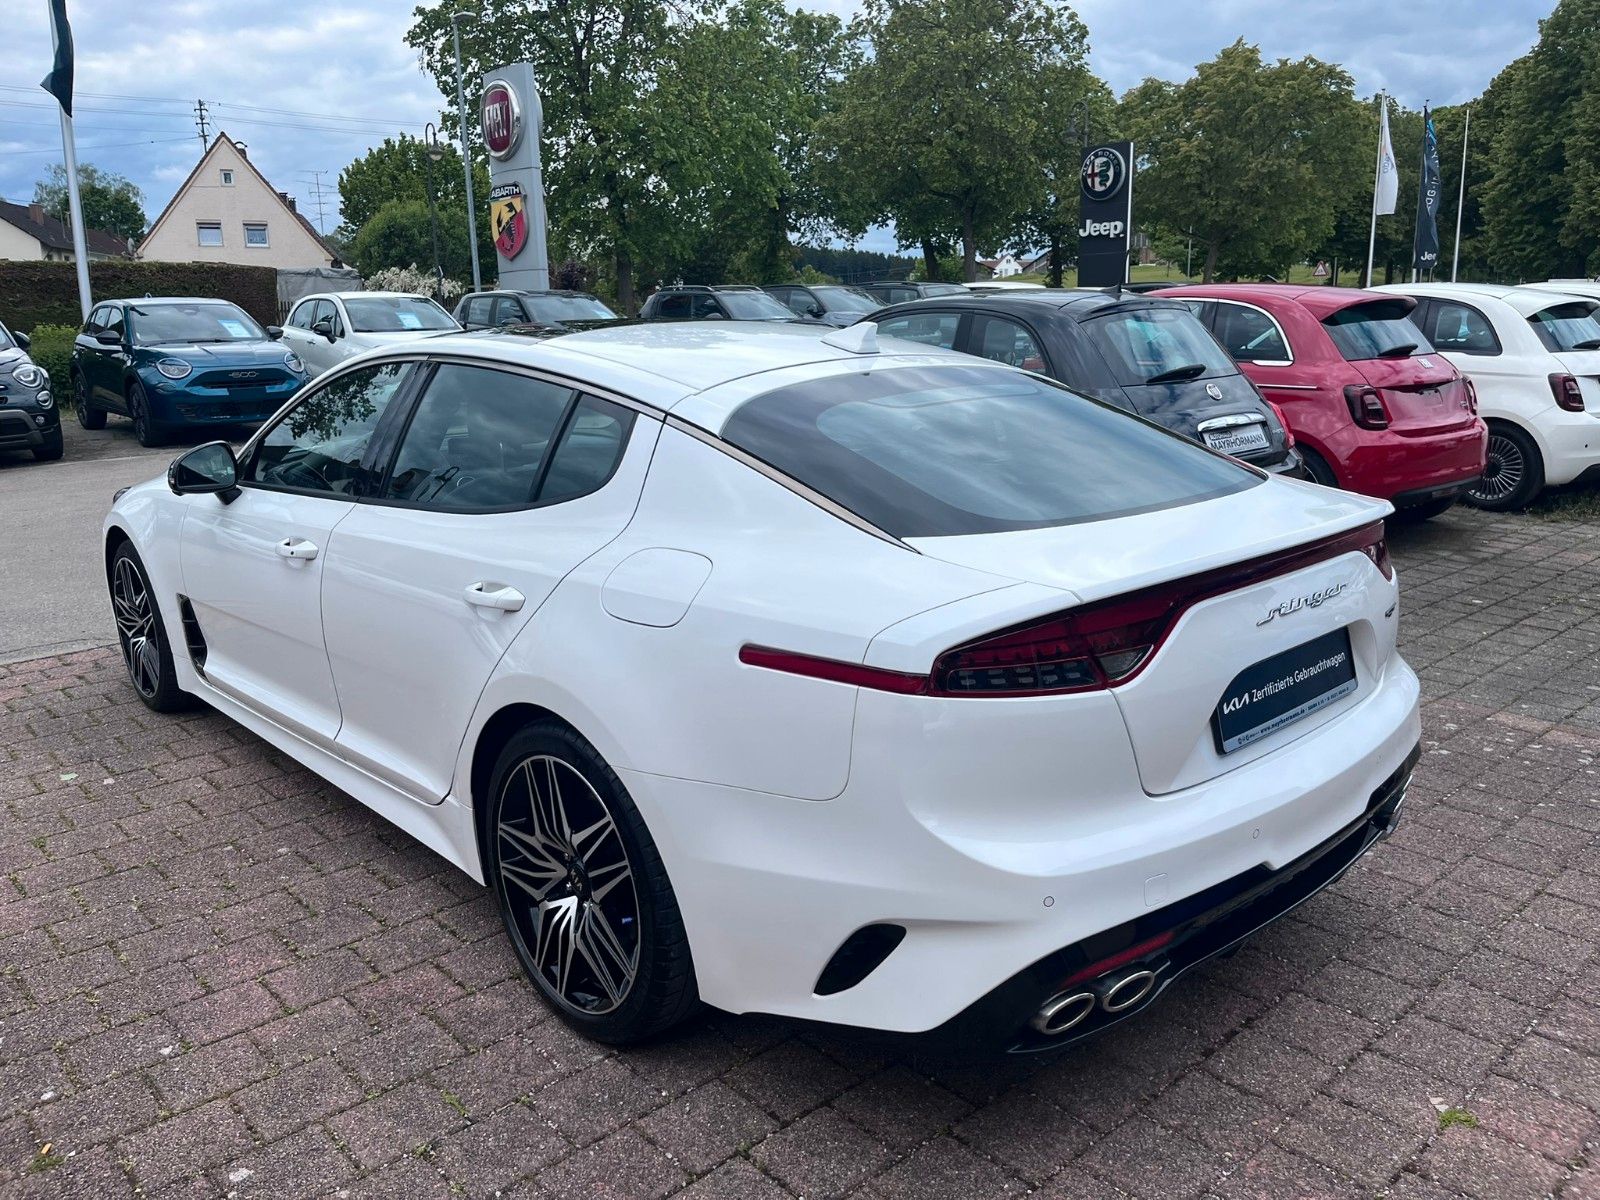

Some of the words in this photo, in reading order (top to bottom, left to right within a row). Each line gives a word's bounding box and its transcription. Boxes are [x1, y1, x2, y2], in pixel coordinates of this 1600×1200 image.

[485, 101, 508, 139] FIAT
[491, 187, 519, 198] ABARTH
[1079, 219, 1124, 238] Jeep
[1223, 692, 1250, 715] KIA
[1251, 675, 1294, 702] Zertifizierte
[1294, 652, 1346, 683] Gebrauchtwagen
